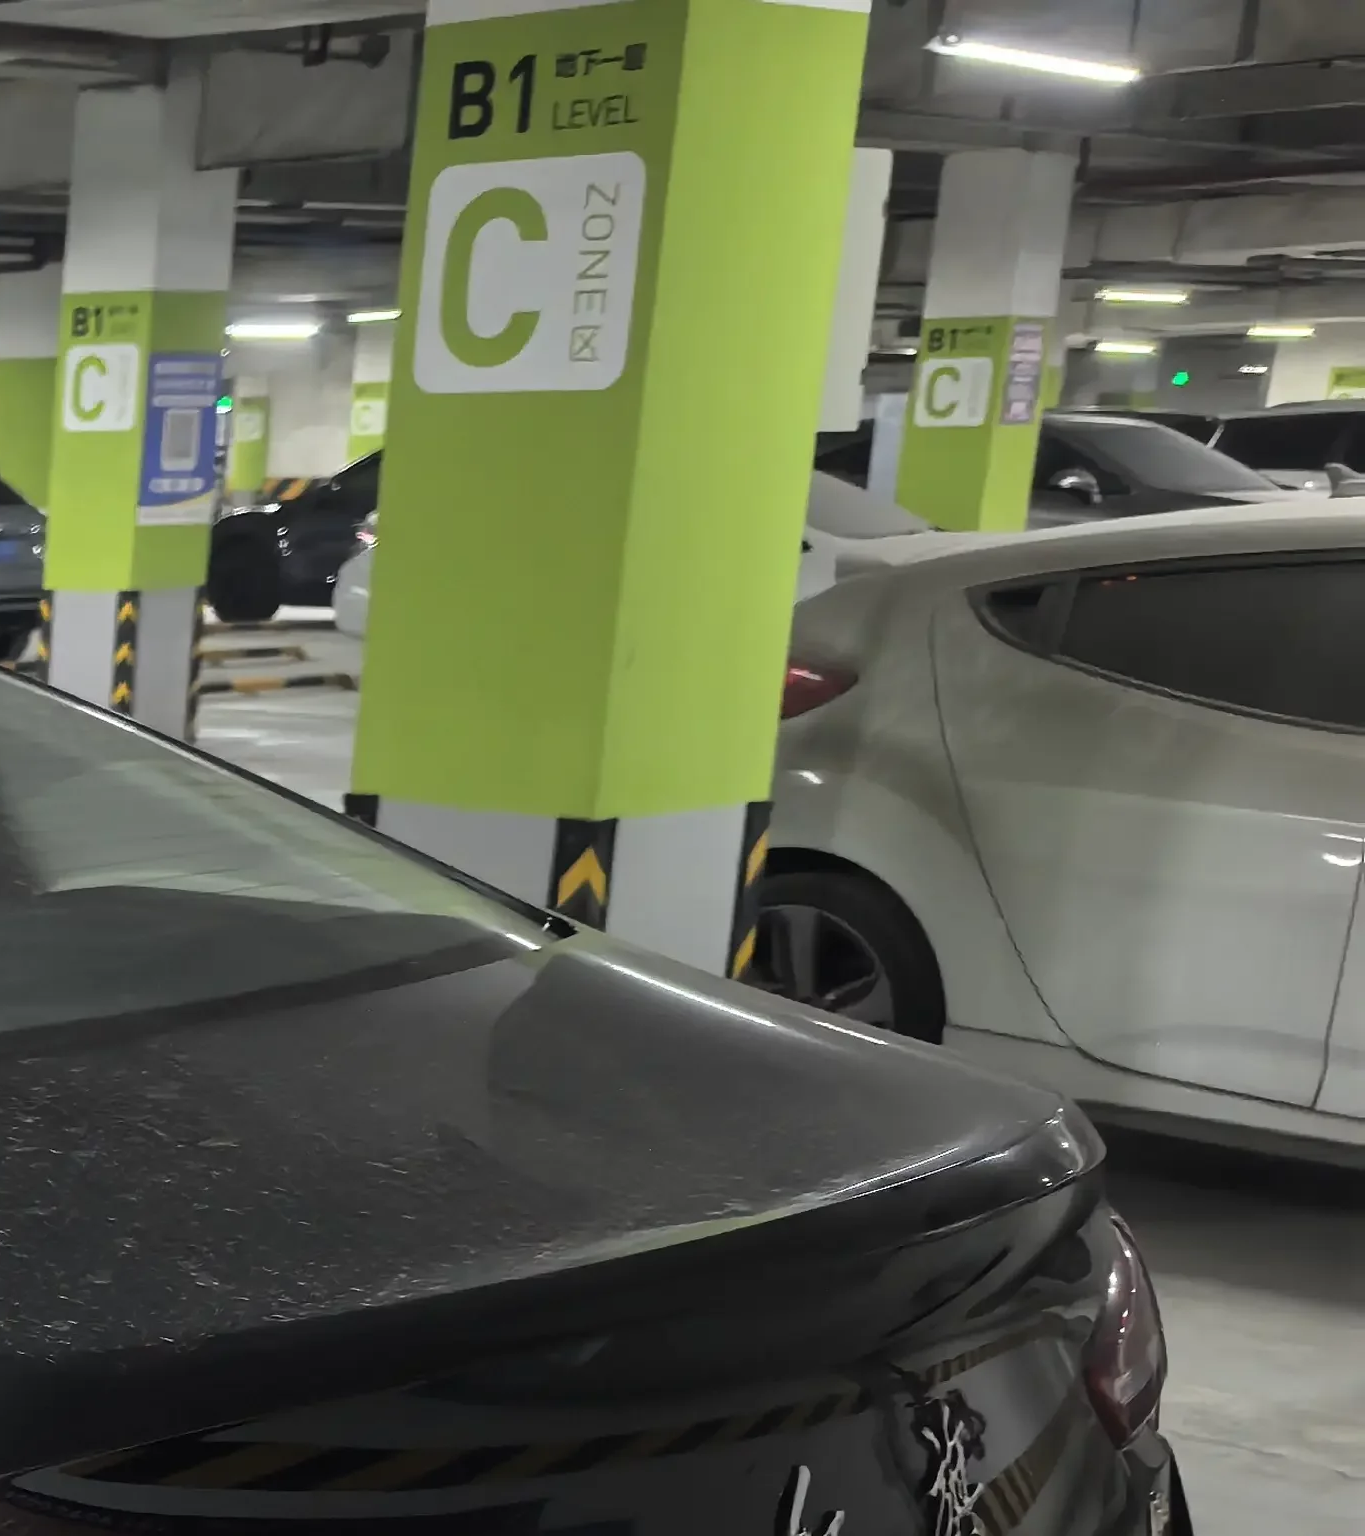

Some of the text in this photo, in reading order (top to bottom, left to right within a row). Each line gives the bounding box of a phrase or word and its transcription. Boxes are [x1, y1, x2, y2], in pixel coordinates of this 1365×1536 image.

[448, 54, 537, 140] B1
[552, 94, 638, 130] LEVEL
[440, 186, 549, 368] C
[573, 182, 621, 315] ZONE
[72, 306, 104, 338] B1
[73, 355, 107, 422] C
[924, 366, 961, 419] C
